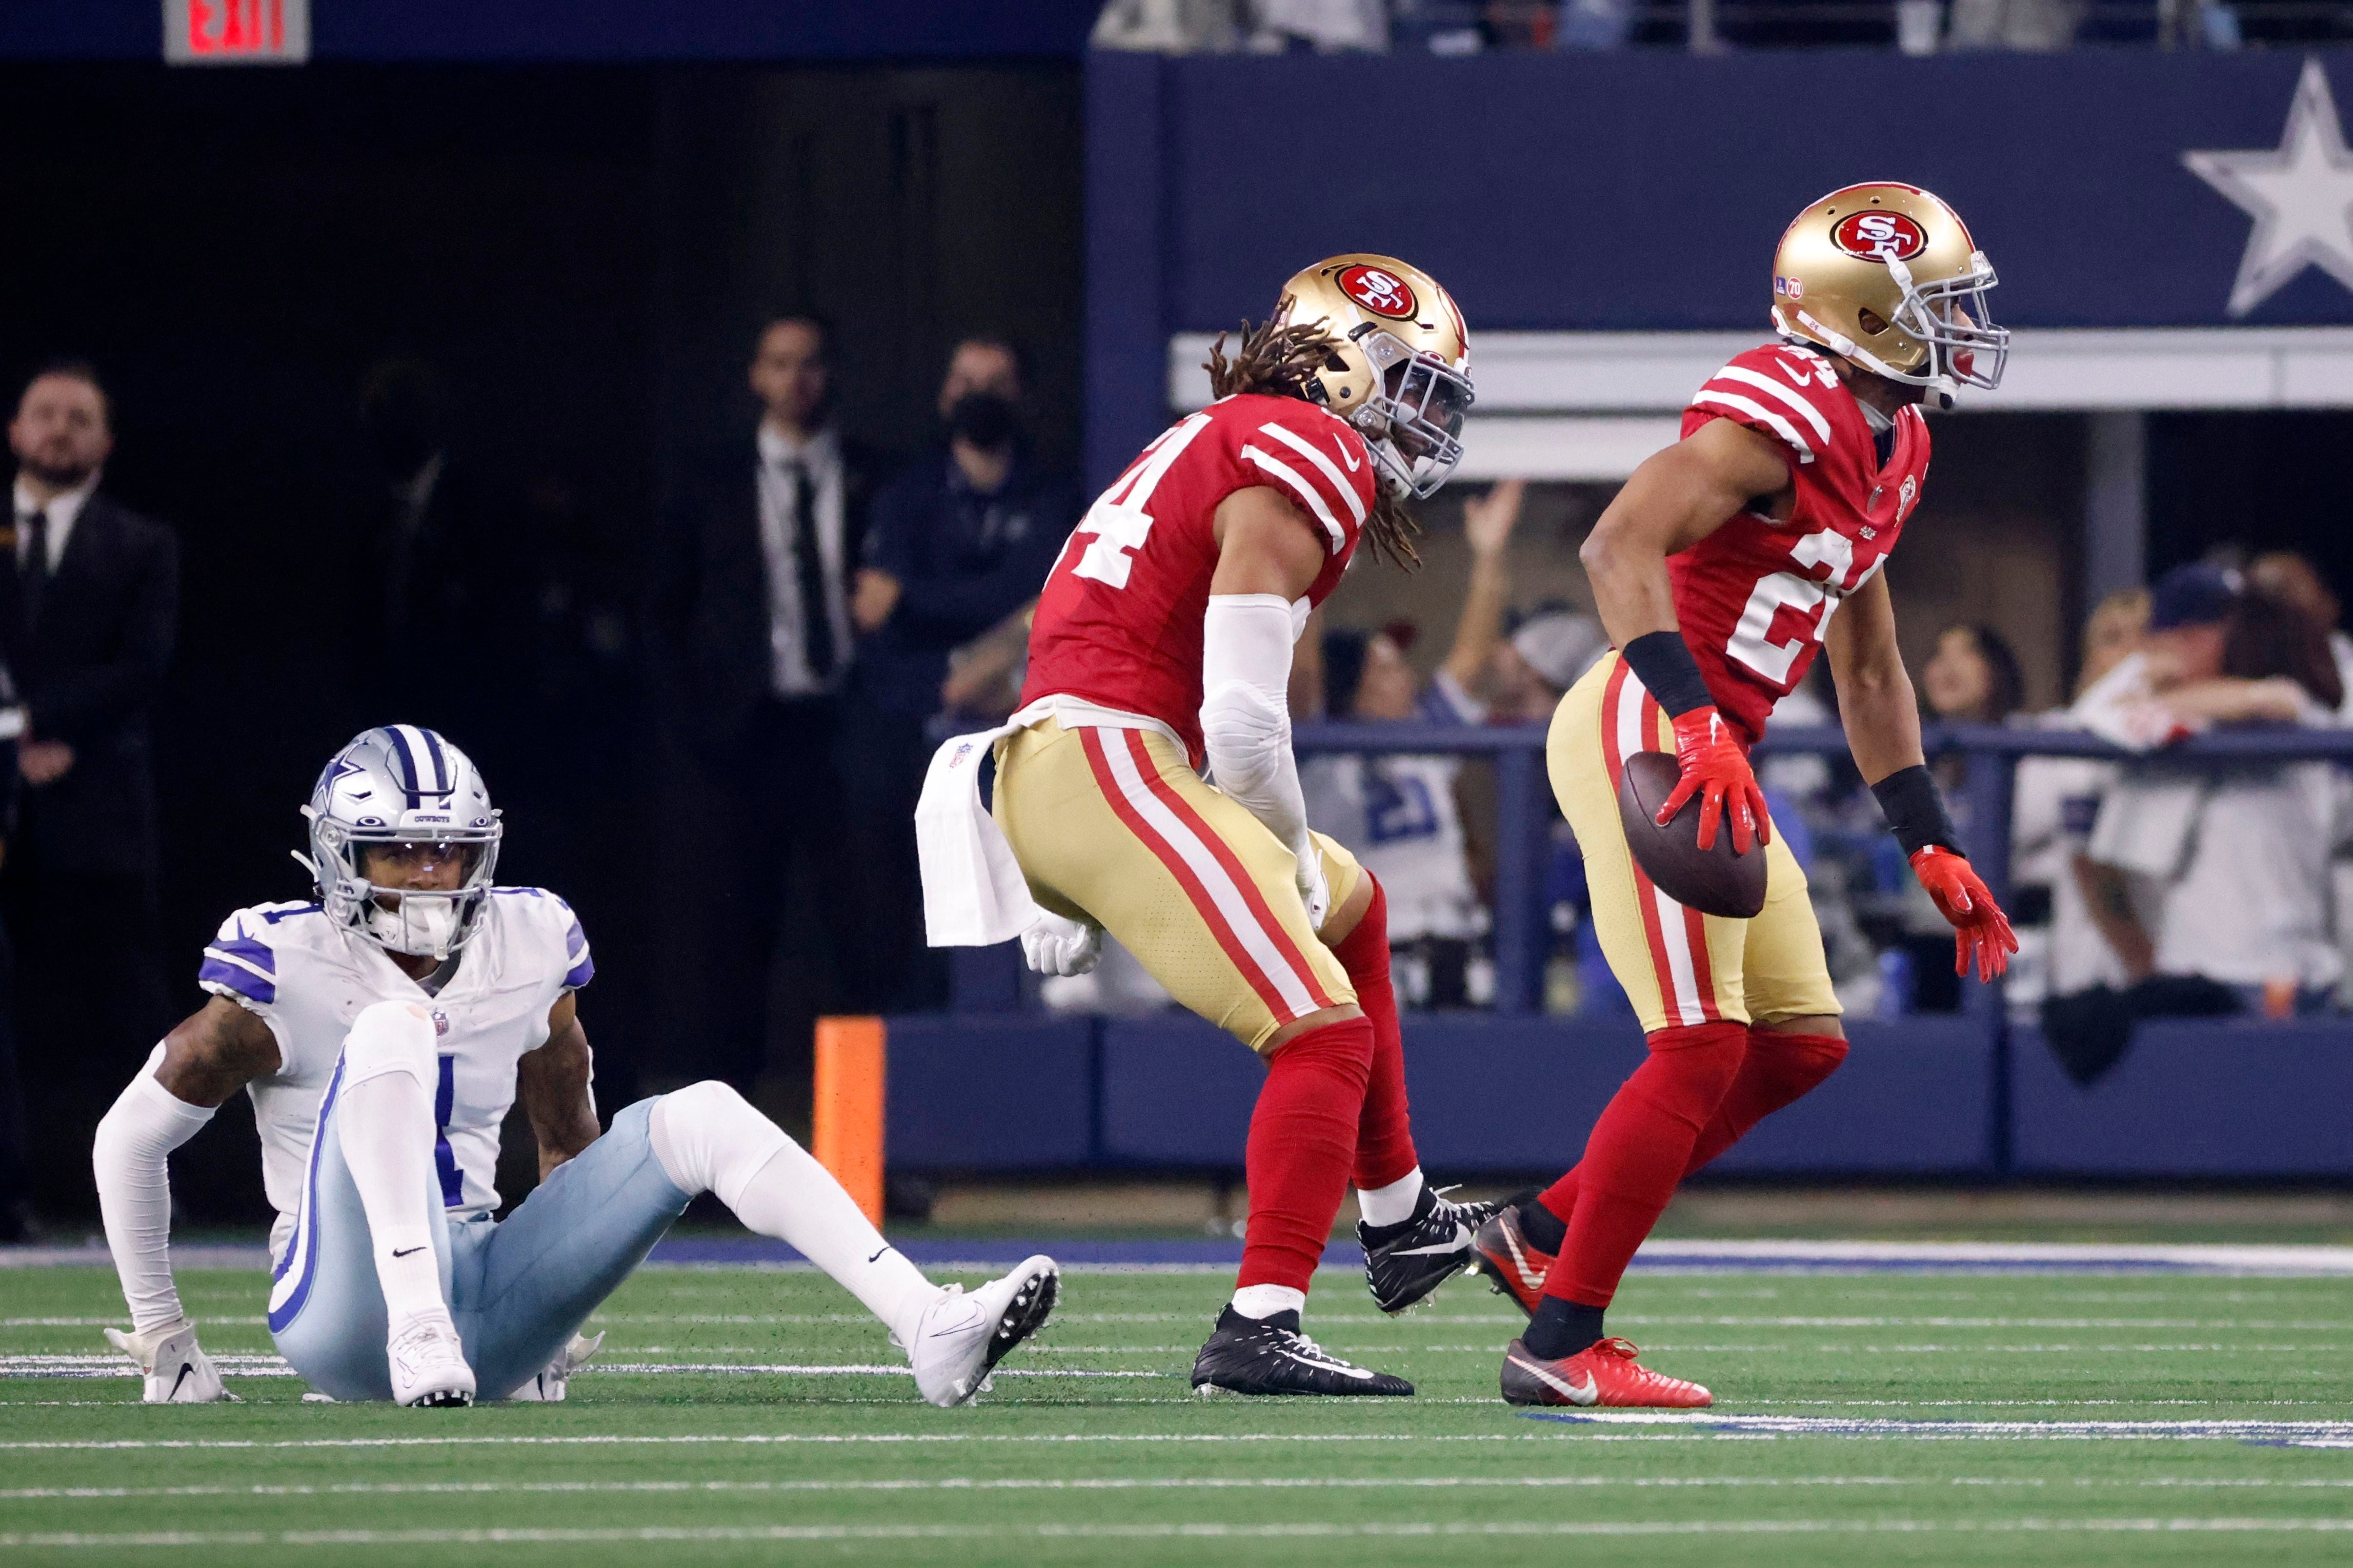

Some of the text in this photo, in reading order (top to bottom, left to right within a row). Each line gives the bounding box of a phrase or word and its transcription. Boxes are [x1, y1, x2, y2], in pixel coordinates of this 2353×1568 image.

[1355, 271, 1403, 309] SF
[1788, 281, 1801, 295] 70
[1809, 321, 1819, 331] 24
